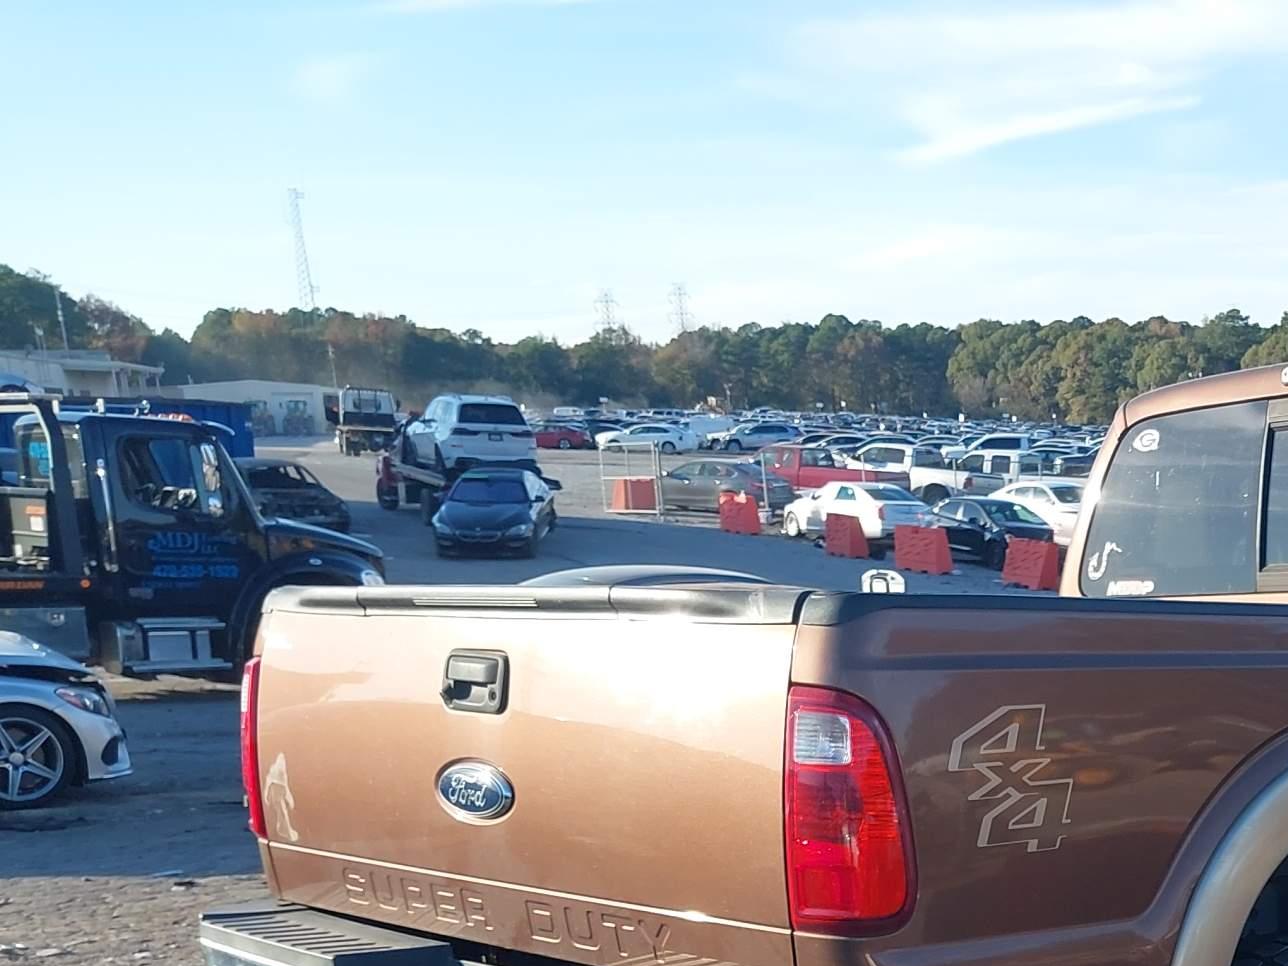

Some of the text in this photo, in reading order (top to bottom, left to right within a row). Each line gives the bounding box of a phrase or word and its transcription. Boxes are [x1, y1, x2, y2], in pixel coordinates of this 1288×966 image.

[448, 773, 488, 807] Ford
[342, 866, 671, 965] SUPER DUTY
